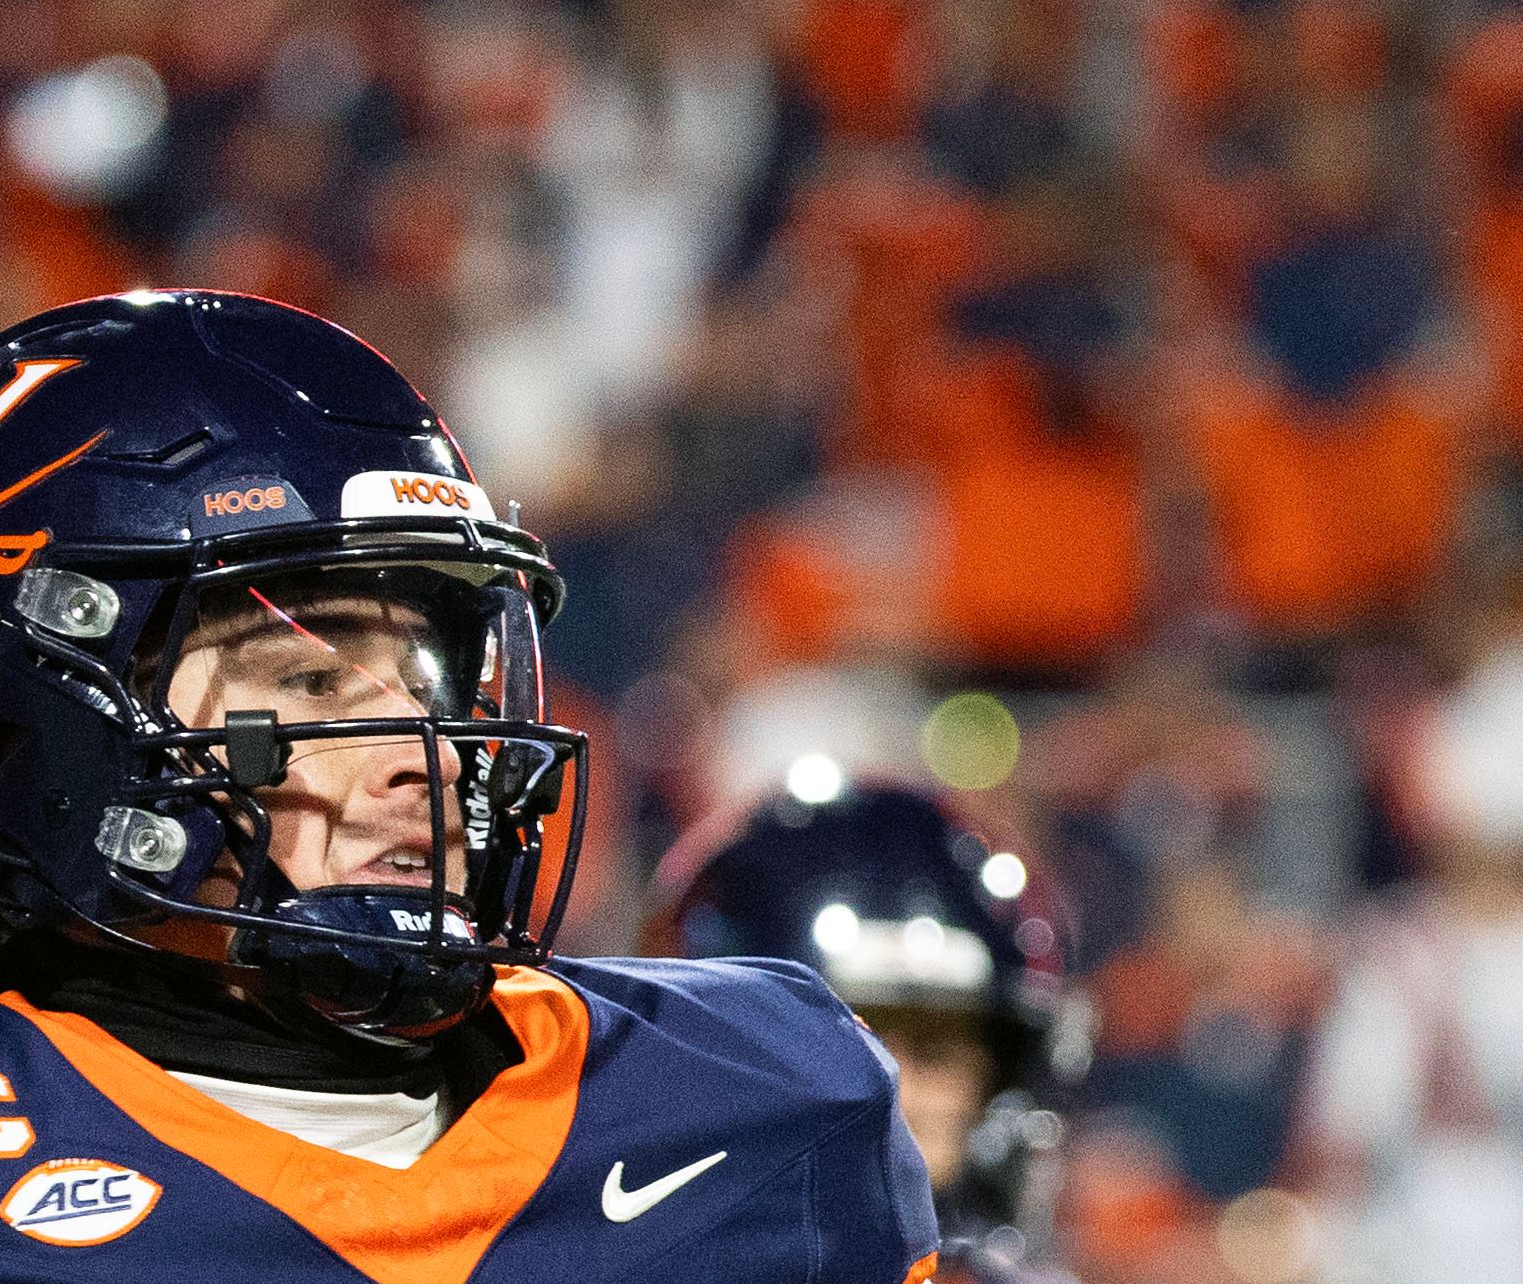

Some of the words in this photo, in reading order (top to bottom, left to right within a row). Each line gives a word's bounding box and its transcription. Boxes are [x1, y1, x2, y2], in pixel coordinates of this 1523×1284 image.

[204, 484, 287, 516] HOOS
[390, 477, 472, 509] HOOS
[26, 1173, 135, 1219] ACC
